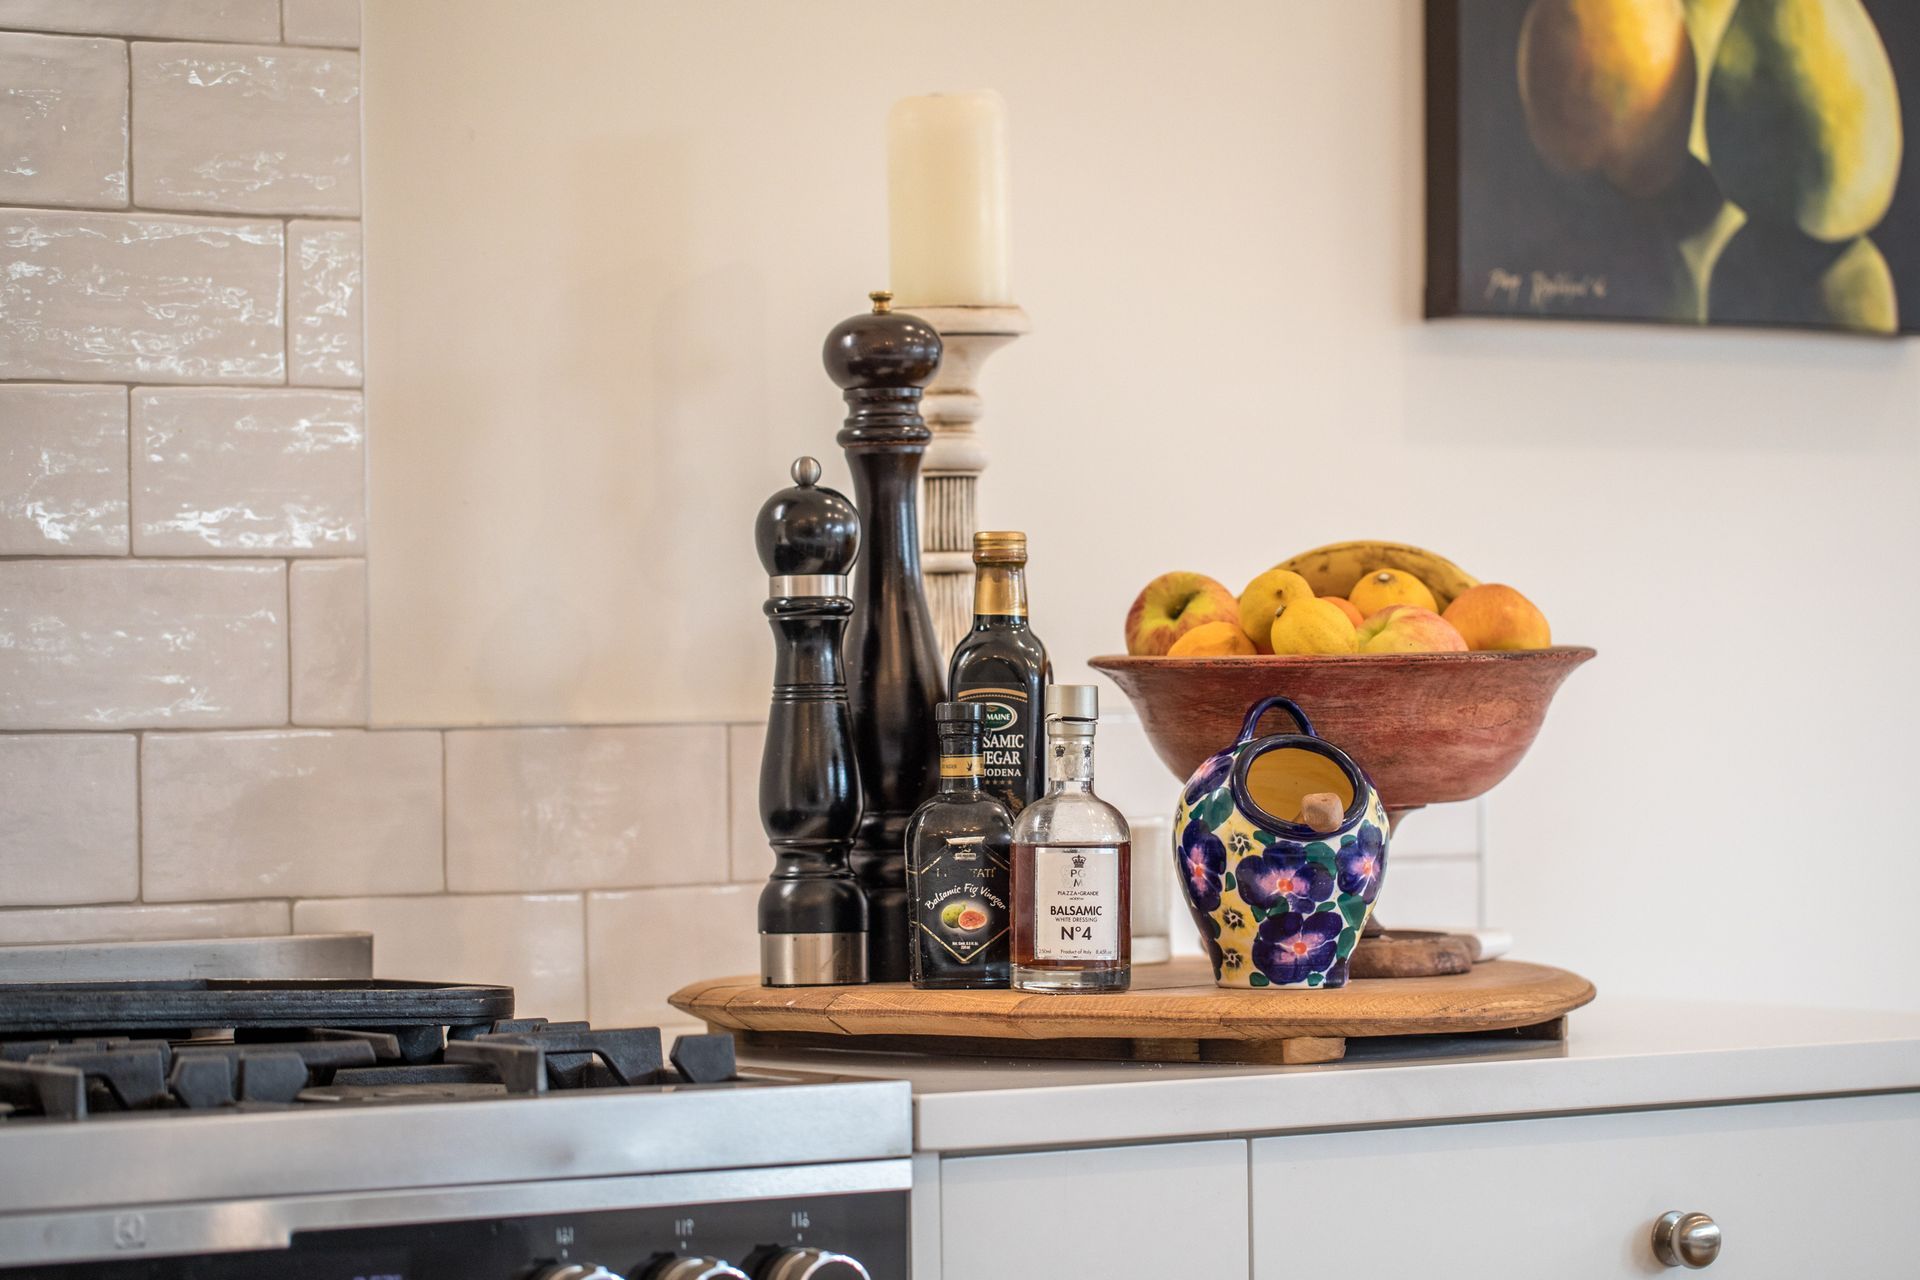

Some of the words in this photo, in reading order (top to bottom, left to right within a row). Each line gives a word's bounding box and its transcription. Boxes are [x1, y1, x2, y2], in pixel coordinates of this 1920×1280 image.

[983, 734, 1024, 748] SAMIC
[983, 750, 1021, 765] EGAR
[925, 885, 961, 910] Balsamic
[964, 883, 978, 898] Fig
[980, 886, 1006, 910] Vinegar
[1050, 905, 1103, 916] BALSAMIC
